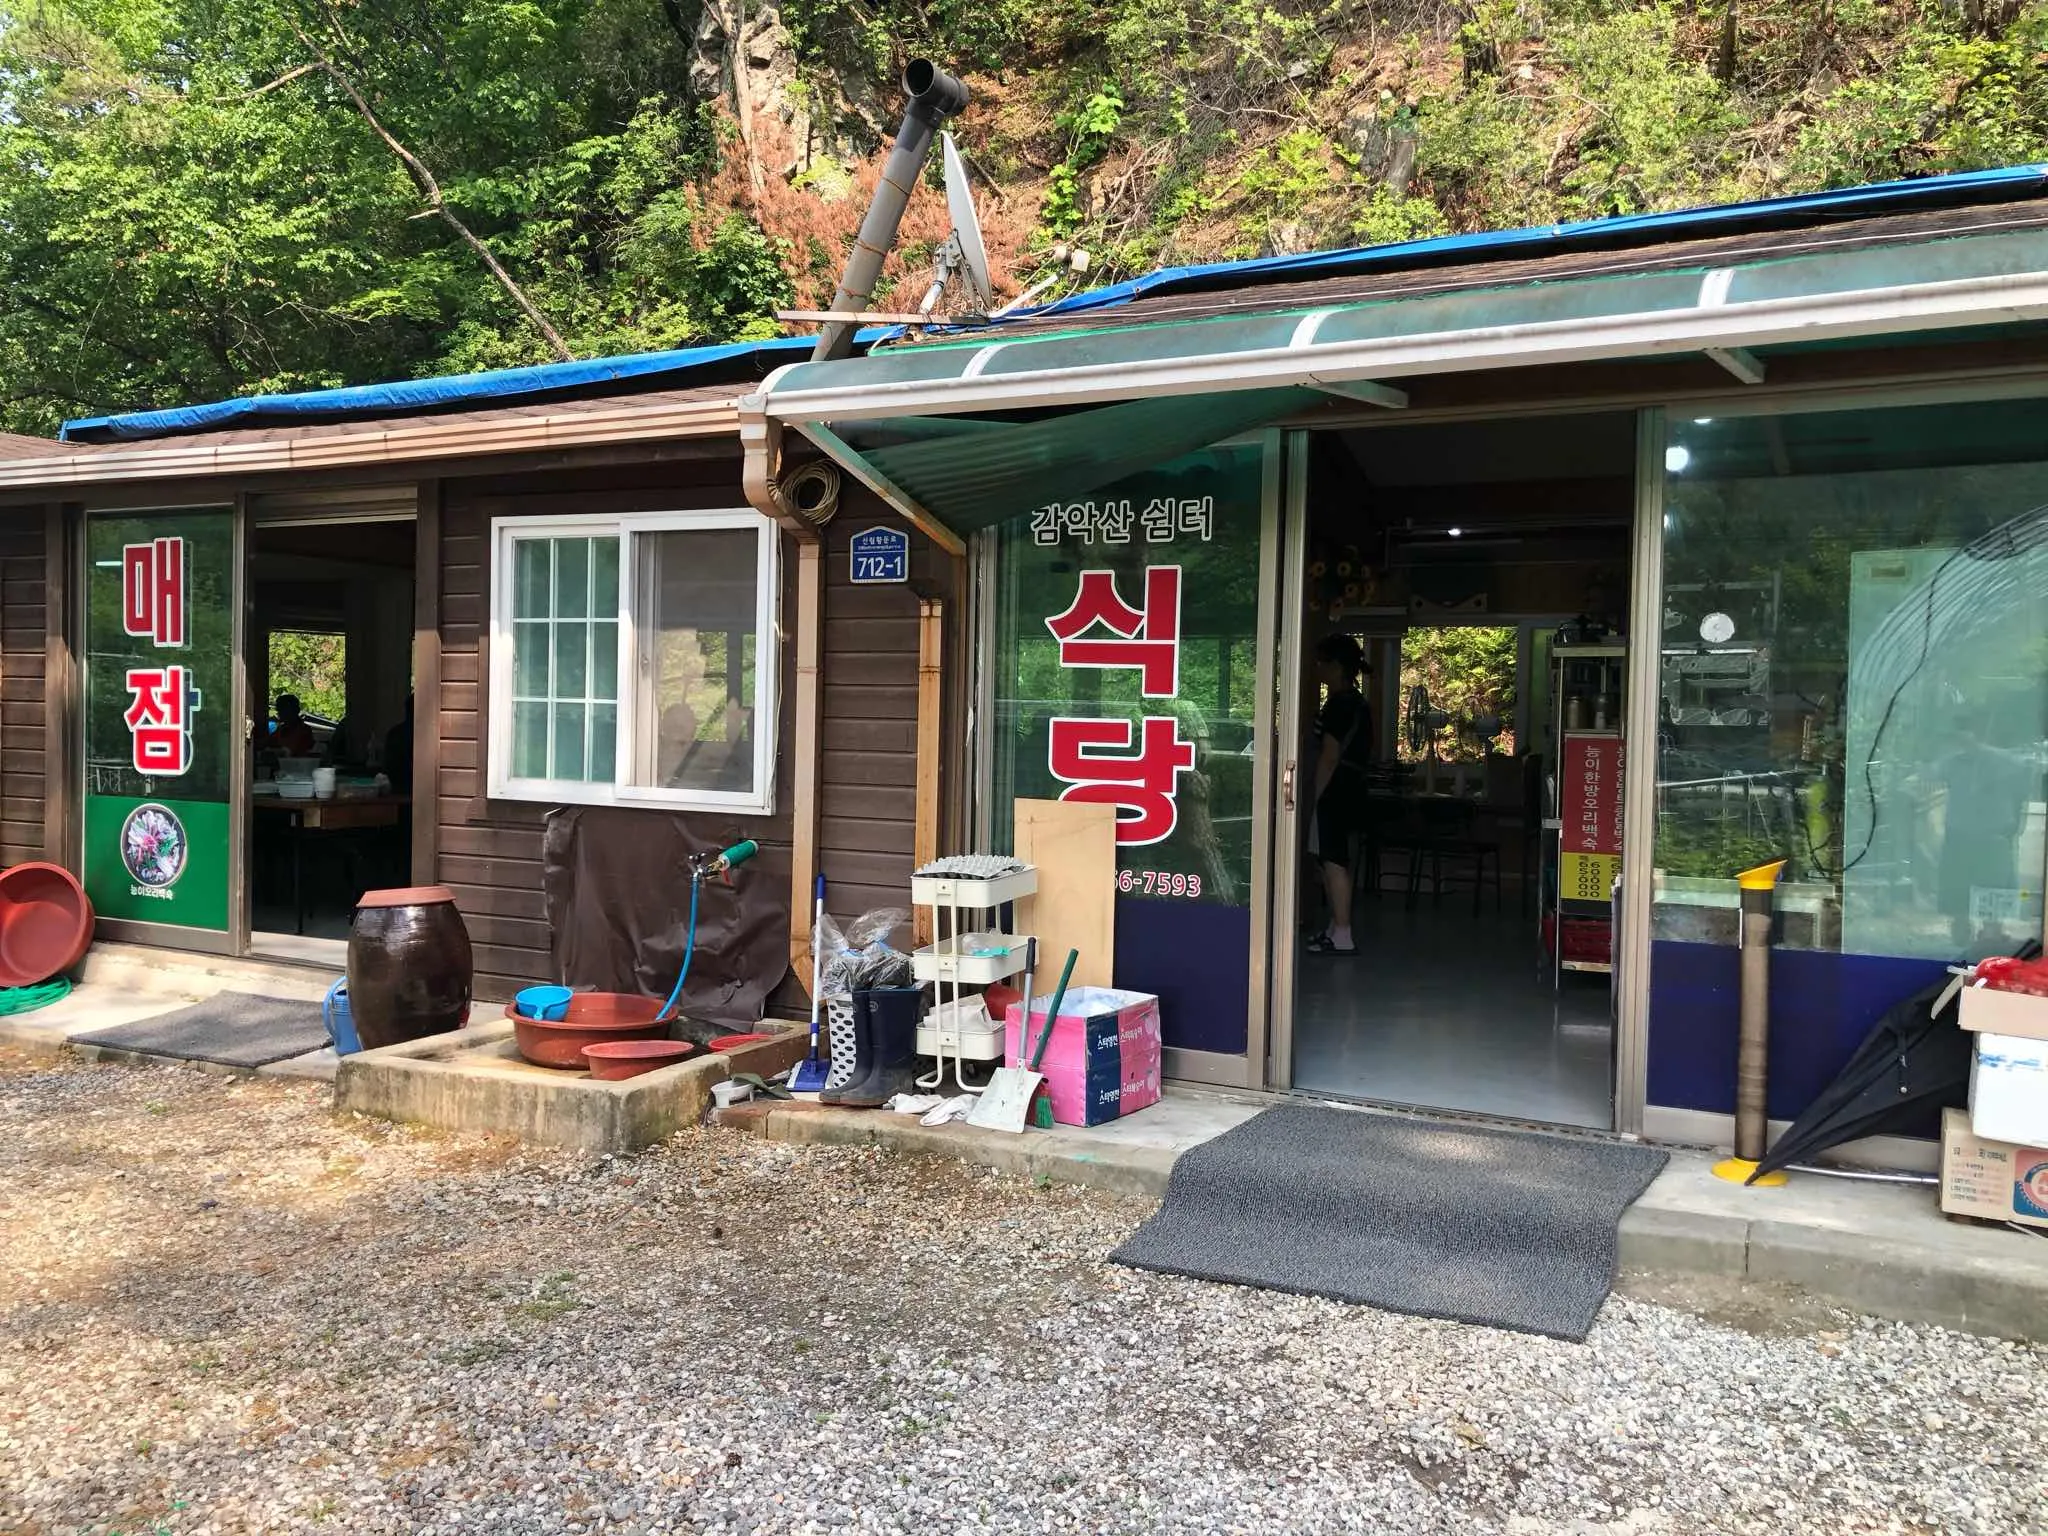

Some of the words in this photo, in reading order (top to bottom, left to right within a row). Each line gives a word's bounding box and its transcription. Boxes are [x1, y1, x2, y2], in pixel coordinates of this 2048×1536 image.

[1031, 501, 1134, 545] 감악산
[1141, 496, 1213, 543] 쉼터
[857, 556, 901, 577] 712-1
[123, 536, 184, 775] 매점
[1045, 565, 1195, 847] 식당
[1582, 746, 1602, 850] 능이한방오리백숙
[130, 885, 174, 901] 능이오리백숙
[1113, 869, 1202, 898] 6-7593
